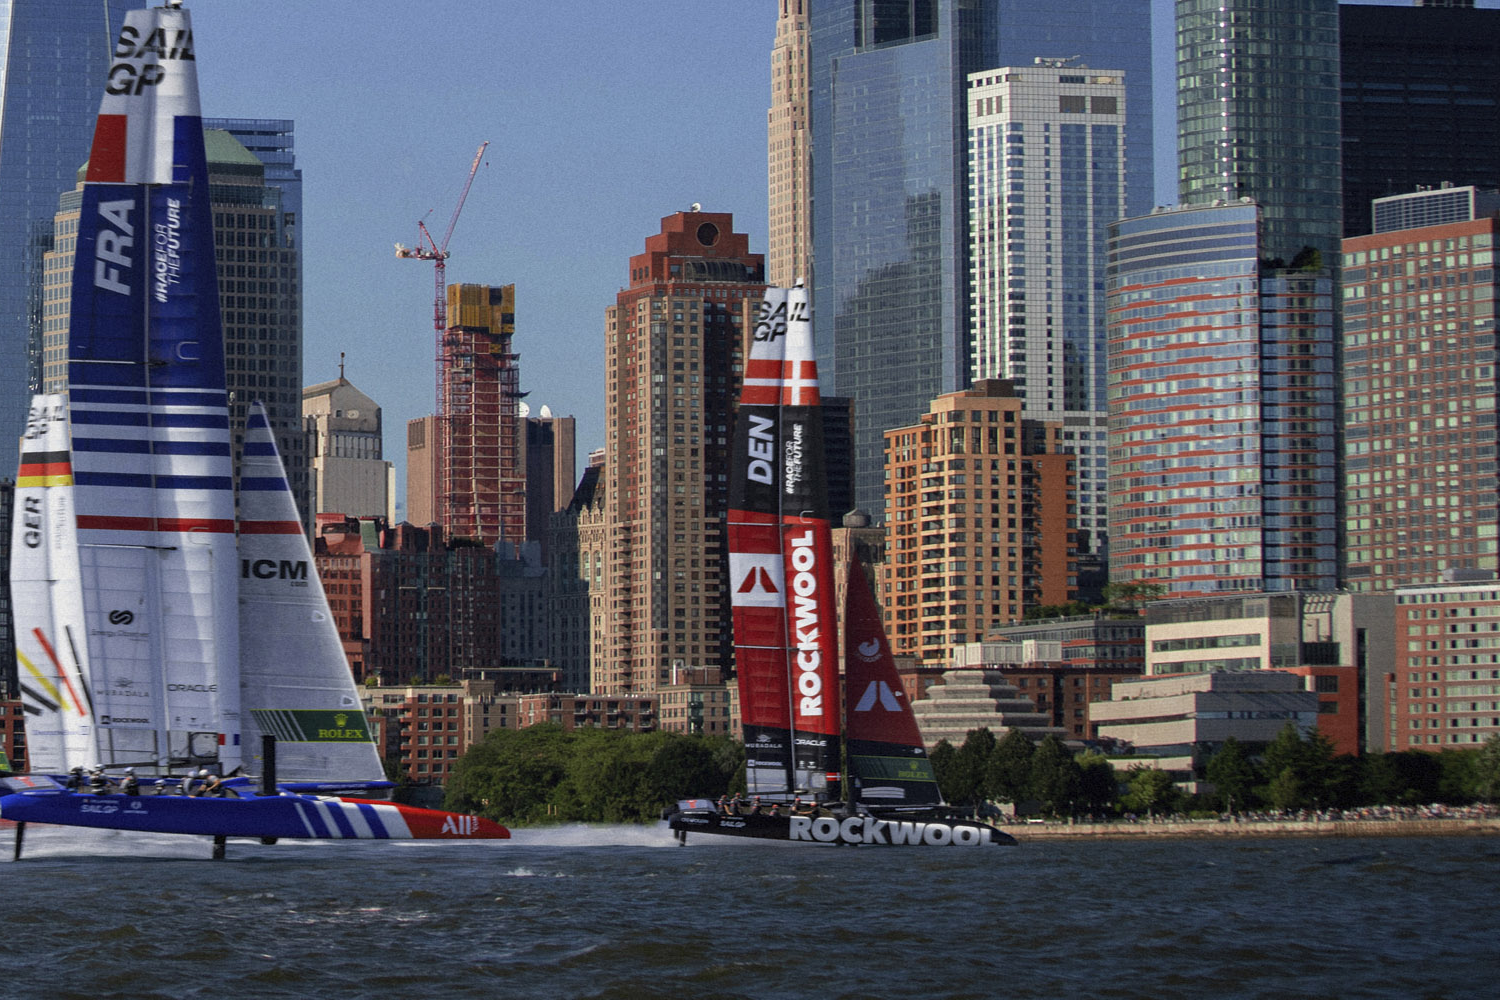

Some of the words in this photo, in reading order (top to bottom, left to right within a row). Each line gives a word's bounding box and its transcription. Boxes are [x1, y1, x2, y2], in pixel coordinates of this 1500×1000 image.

[115, 25, 195, 61] SAIL
[105, 62, 166, 96] GP
[94, 199, 136, 295] FRA
[167, 197, 181, 285] THEFUTURE
[155, 222, 171, 304] #RACEFOR
[759, 300, 811, 323] SAIL
[754, 321, 788, 343] GP
[747, 415, 775, 486] DEN
[785, 440, 795, 495] #RACEFOR
[793, 423, 804, 483] THEFUTURE
[23, 496, 42, 549] GER
[241, 559, 309, 580] ICM
[791, 530, 823, 716] ROCKWOOL
[97, 689, 150, 697] MUBADALA
[167, 683, 218, 693] ORACLE
[318, 729, 364, 739] ROLEX
[793, 739, 827, 747] ORACLE
[790, 815, 998, 847] ROCKWOOL
